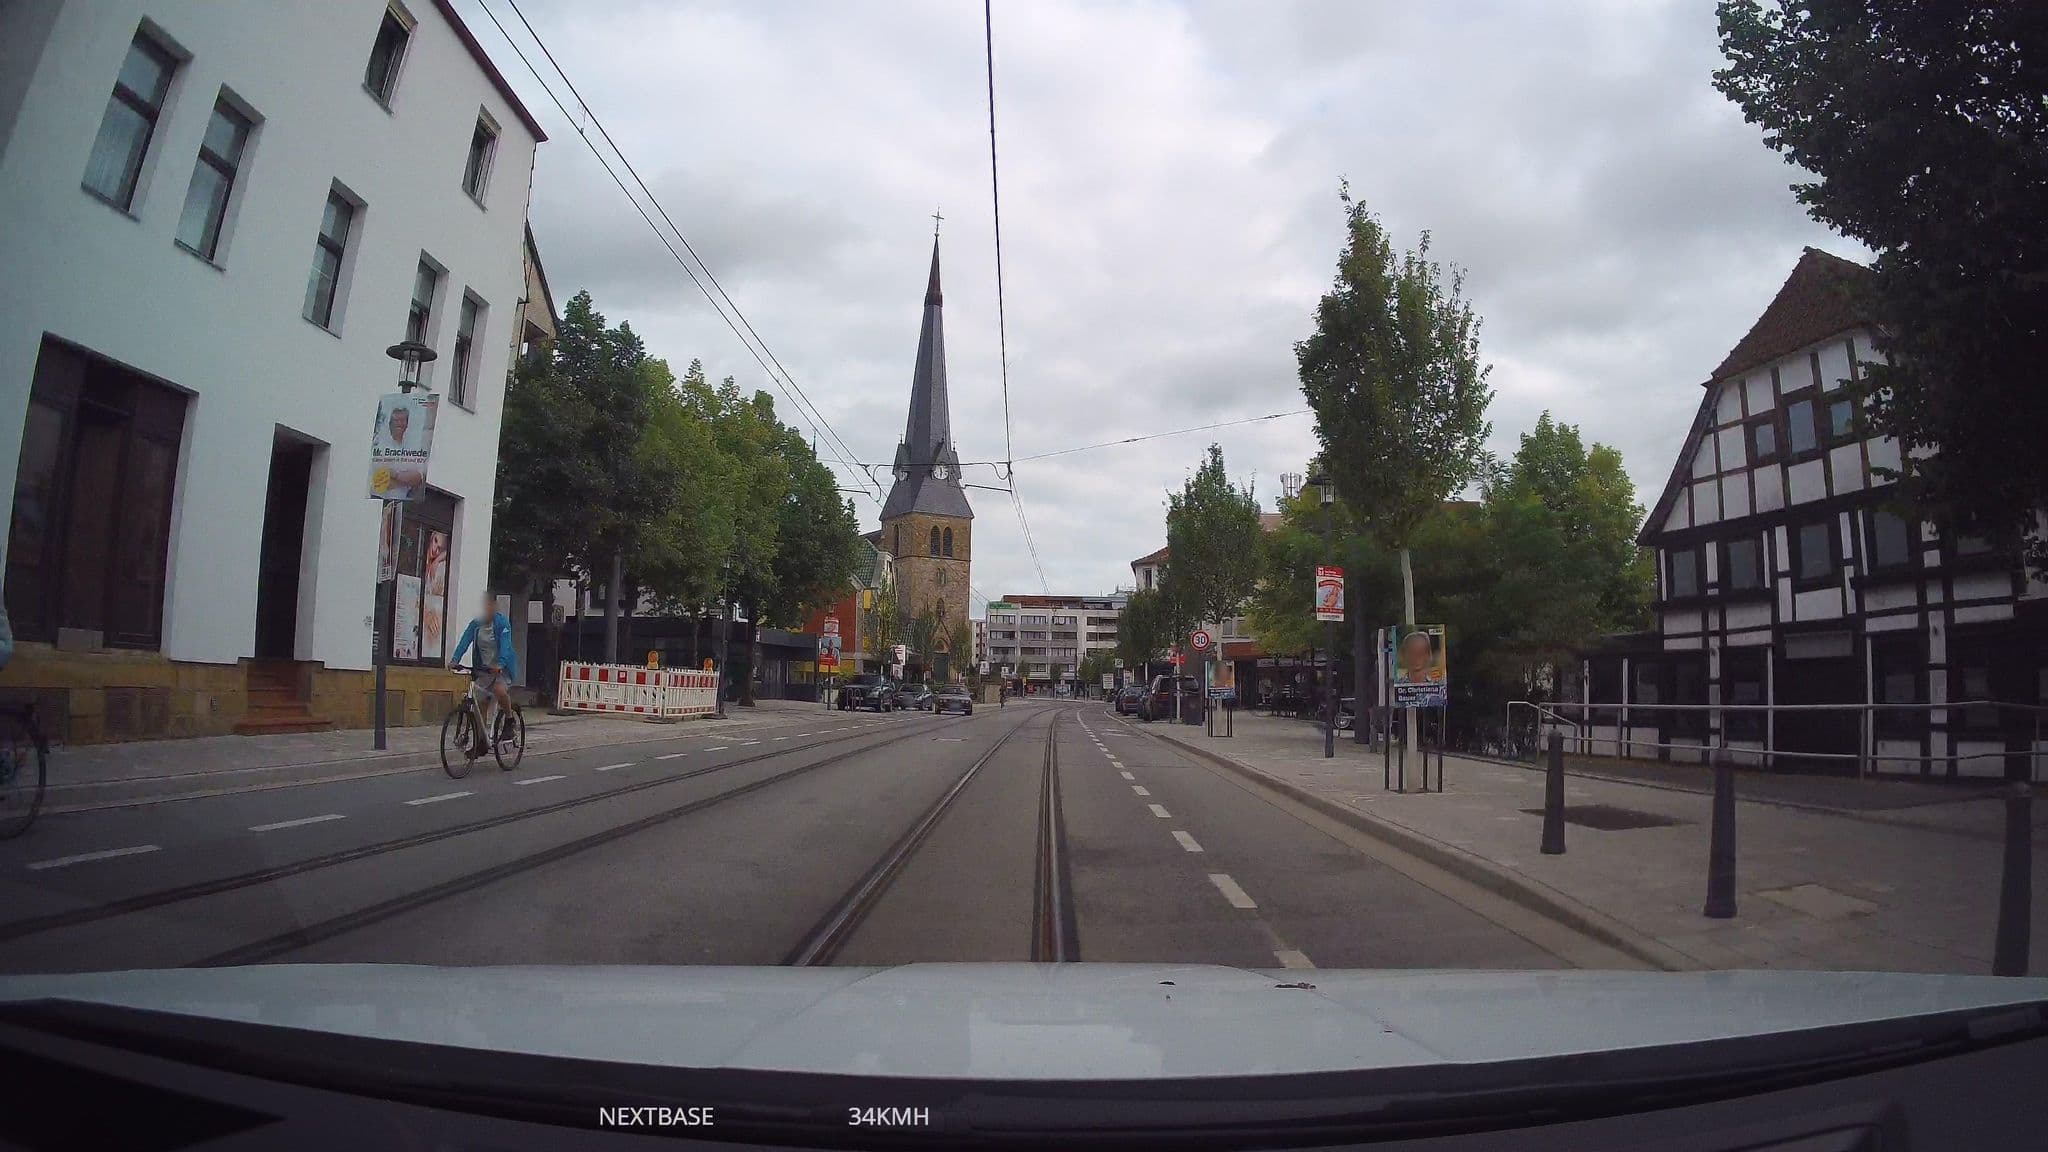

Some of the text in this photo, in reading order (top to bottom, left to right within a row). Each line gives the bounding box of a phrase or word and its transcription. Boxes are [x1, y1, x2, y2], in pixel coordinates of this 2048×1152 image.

[372, 447, 428, 458] Mr. Brackwede
[1195, 635, 1206, 645] 30
